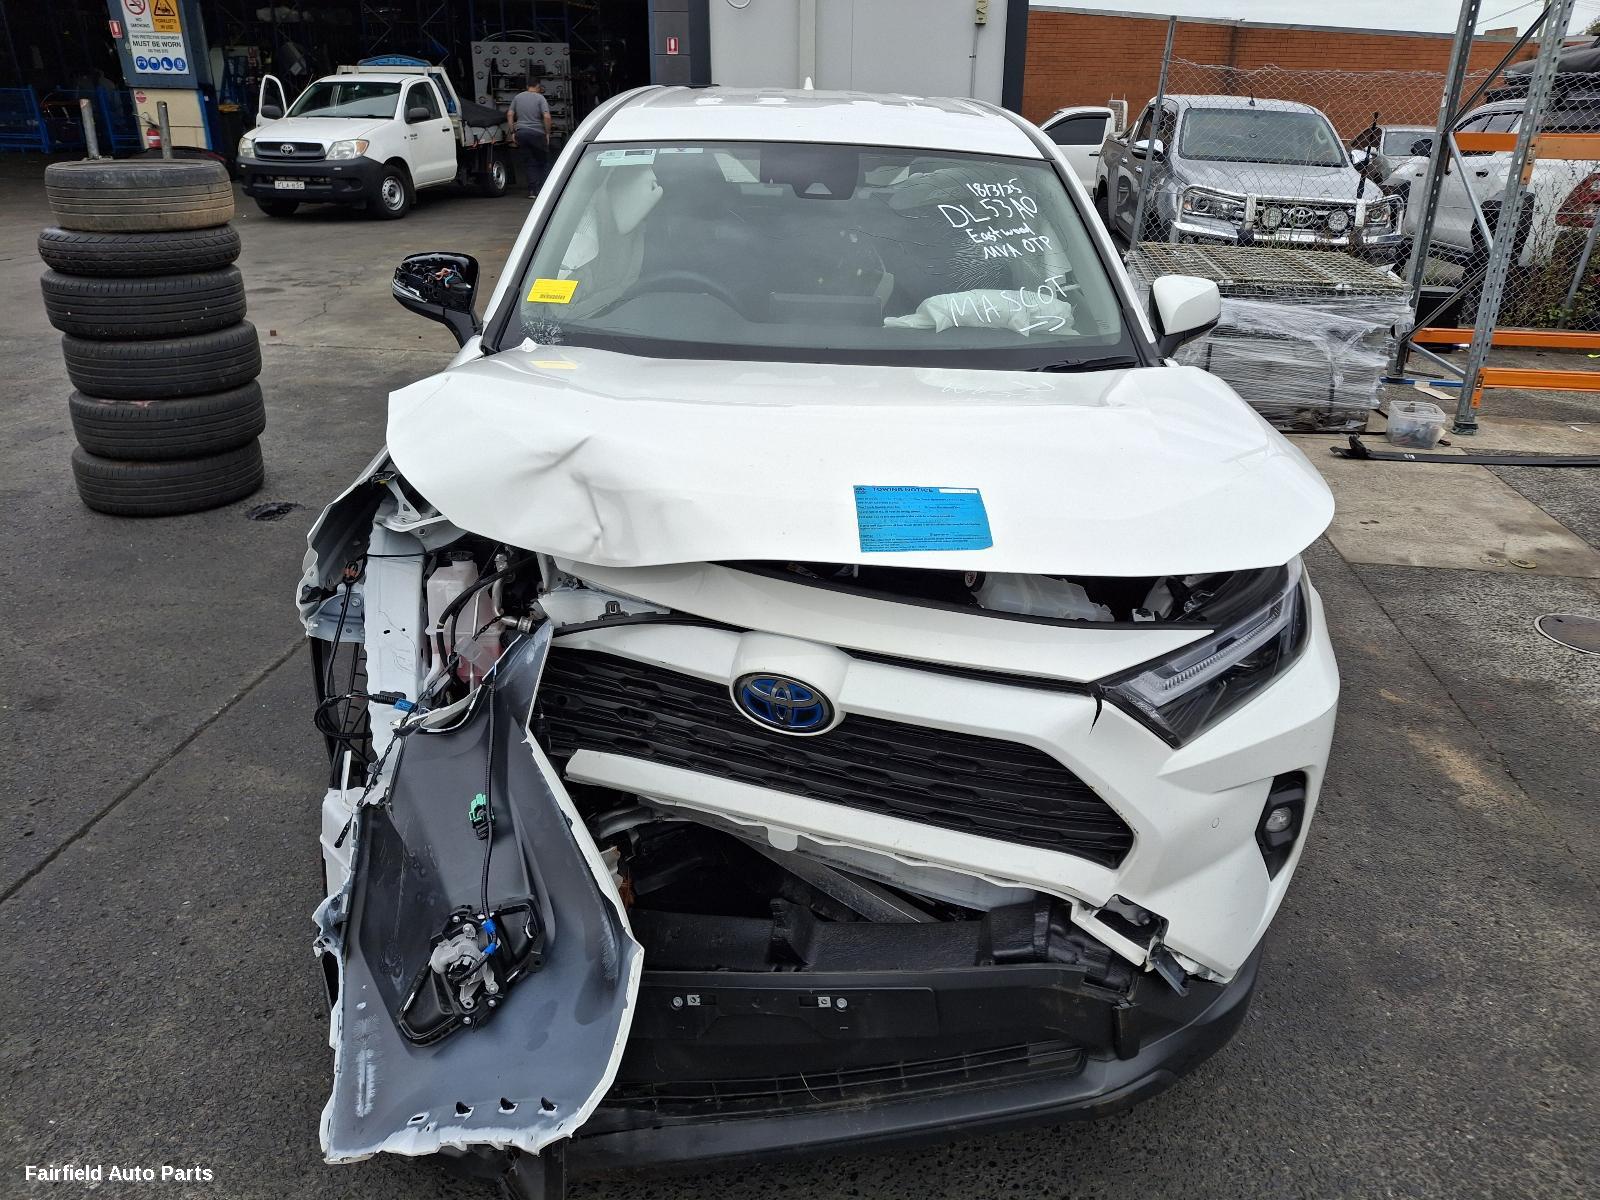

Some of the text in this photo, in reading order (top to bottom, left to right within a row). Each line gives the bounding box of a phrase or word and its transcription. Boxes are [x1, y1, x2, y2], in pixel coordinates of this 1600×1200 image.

[983, 235, 1053, 259] MVA OTP
[949, 275, 1067, 327] MASCOT
